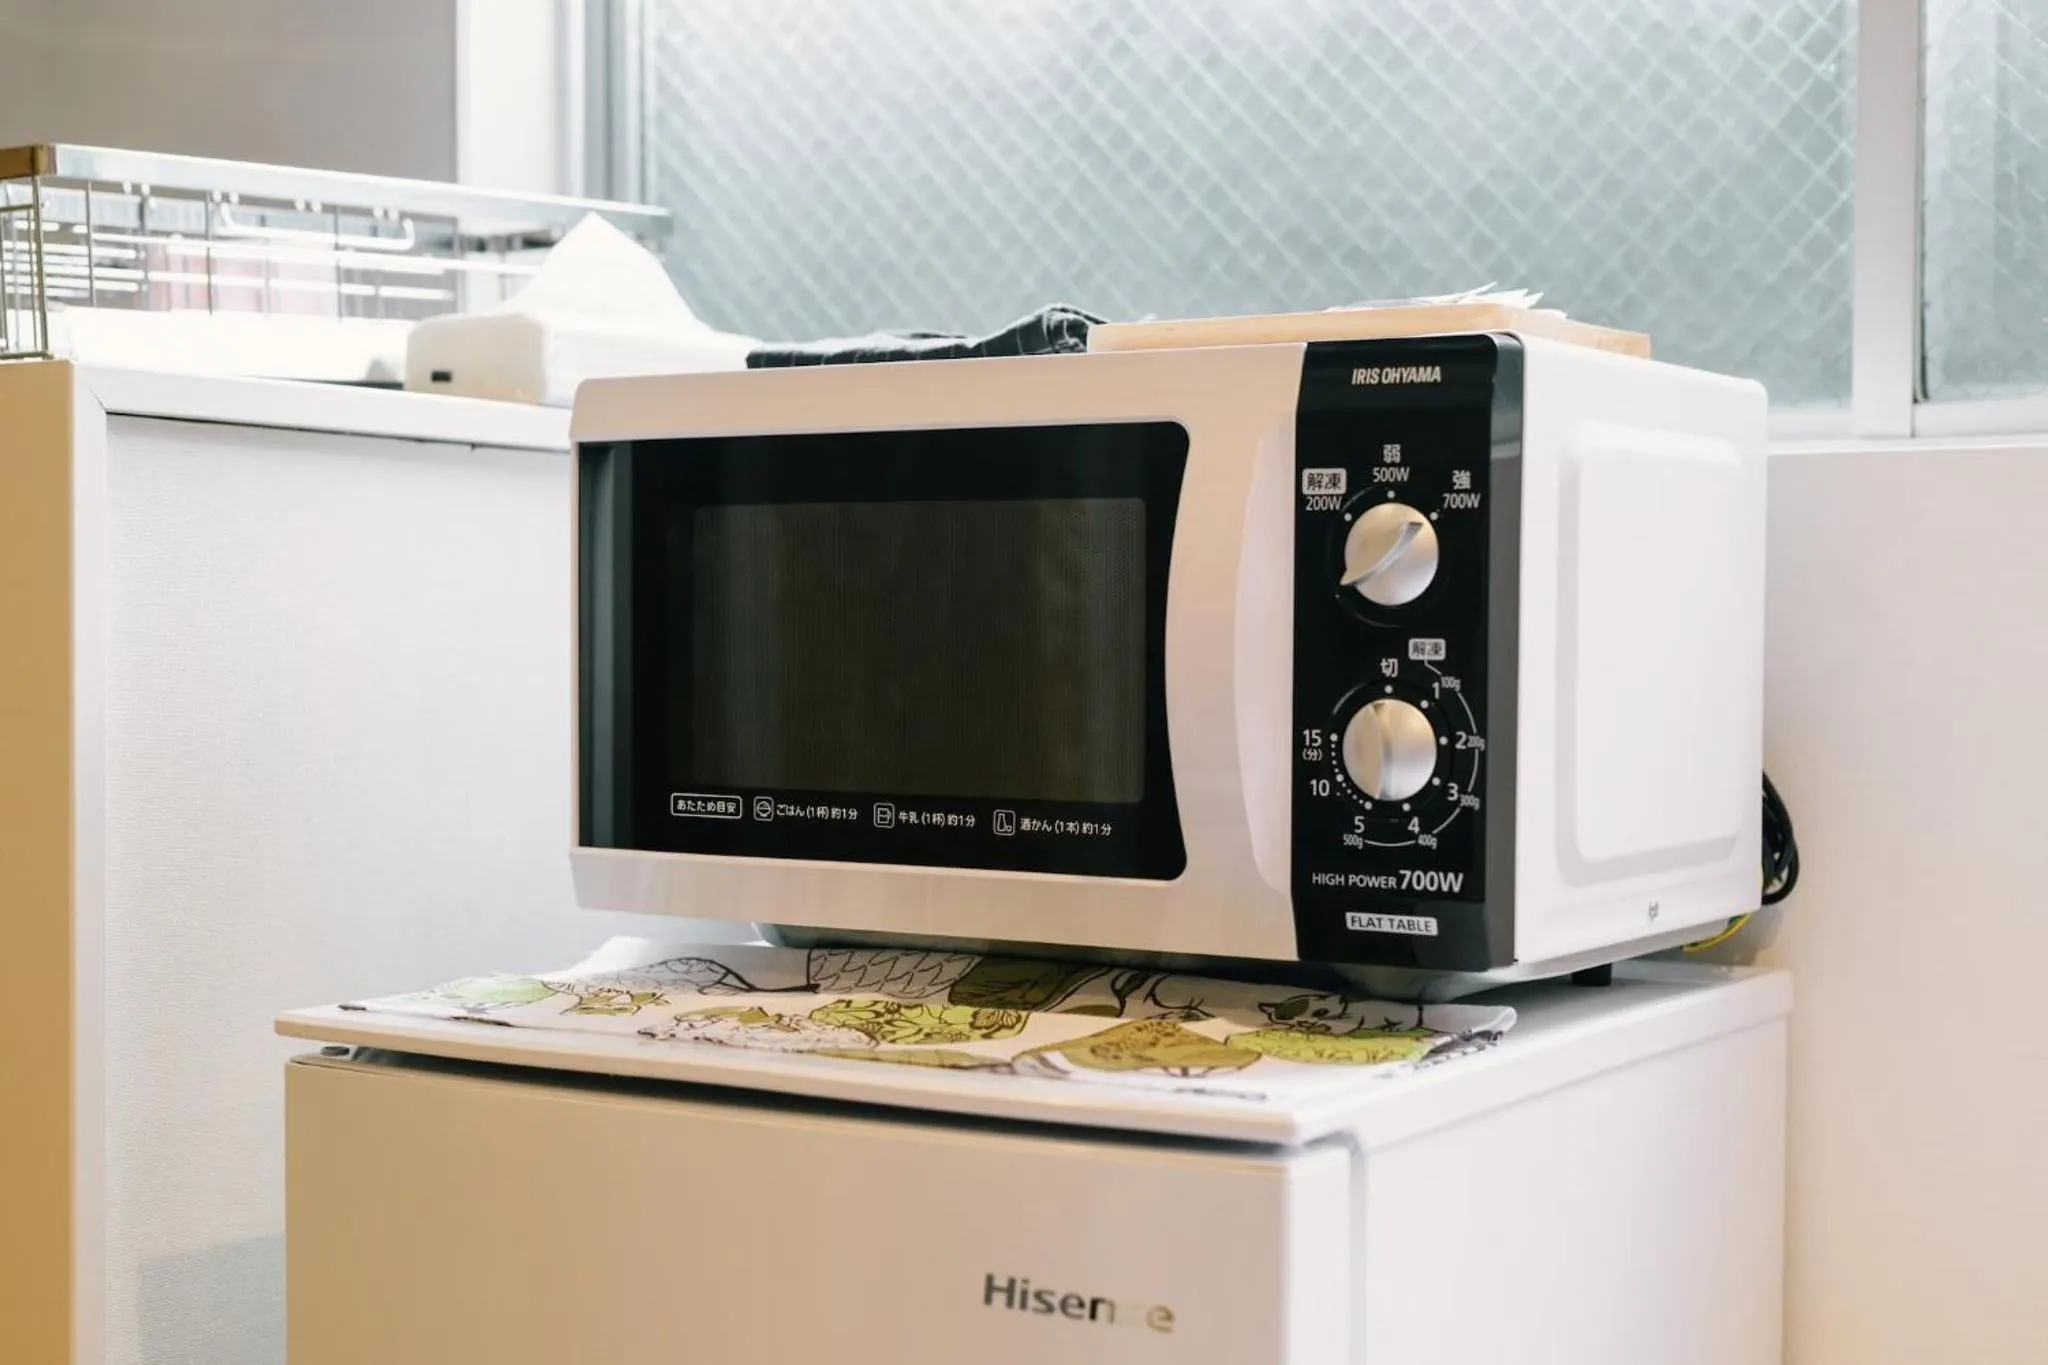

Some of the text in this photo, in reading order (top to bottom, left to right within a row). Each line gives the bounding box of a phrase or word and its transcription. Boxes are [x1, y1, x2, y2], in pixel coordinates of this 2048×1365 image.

[1352, 366, 1442, 385] IRIS OHYAMA
[1383, 444, 1401, 464] 弱
[1306, 472, 1342, 491] 解凍
[1373, 467, 1410, 482] 500W
[1452, 470, 1472, 490] 強
[1305, 496, 1342, 511] 200W
[1442, 493, 1481, 508] 700W
[1412, 641, 1443, 657] 解凍
[1381, 658, 1399, 677] 切
[1432, 676, 1461, 699] 1 100g
[1303, 729, 1322, 746] 15
[1455, 731, 1466, 749] 2
[1310, 779, 1330, 796] 10
[1447, 783, 1458, 800] 3
[676, 799, 737, 814] あたため目安
[776, 804, 804, 817] ごはん
[1354, 816, 1364, 832] 5
[1408, 817, 1420, 834] 4
[1343, 834, 1364, 850] 500g
[1417, 834, 1437, 850] 400g
[1312, 869, 1463, 893] HIGH POWER 700W
[1350, 915, 1432, 934] FLAT TABLE
[983, 1272, 1175, 1334] Hisene
